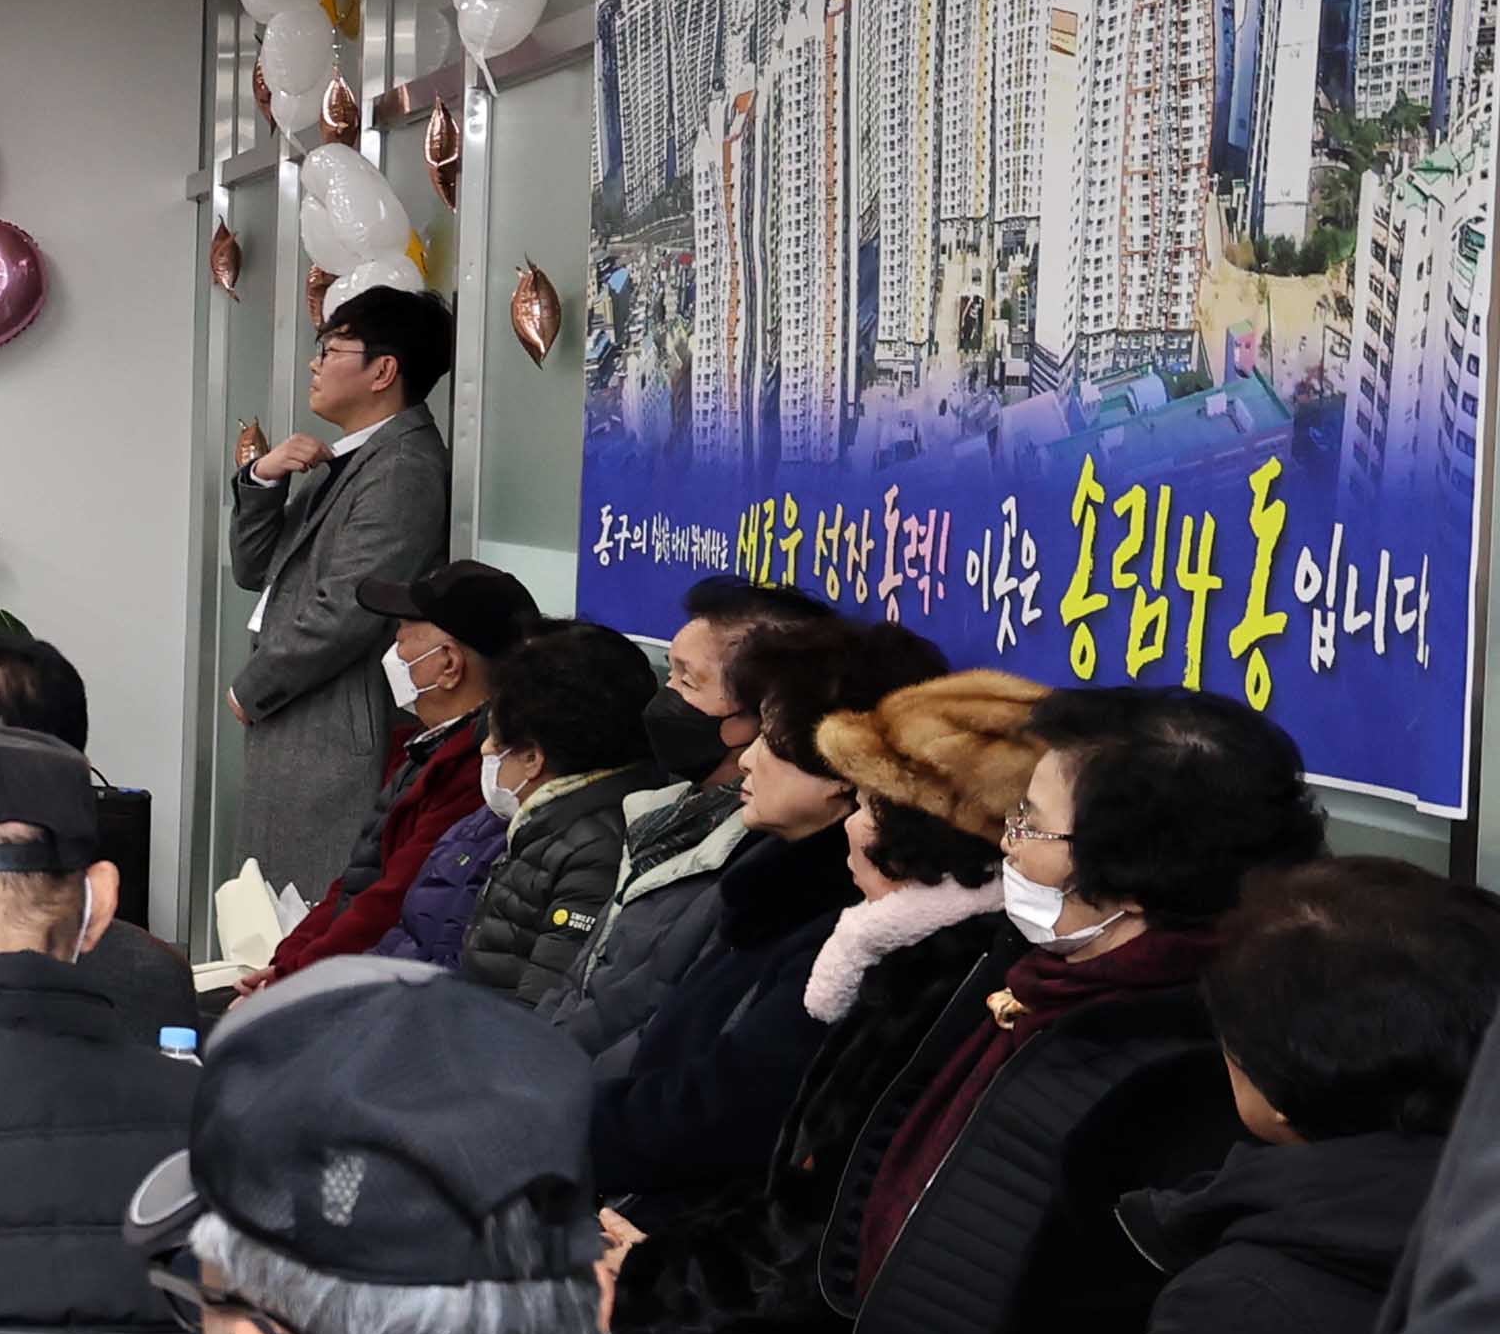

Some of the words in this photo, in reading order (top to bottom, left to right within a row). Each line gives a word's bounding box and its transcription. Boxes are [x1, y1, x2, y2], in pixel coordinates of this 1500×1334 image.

[593, 504, 648, 566] 동구의
[813, 503, 875, 603] 성장
[878, 483, 950, 624] 동력!
[966, 495, 1042, 655] 이곳은
